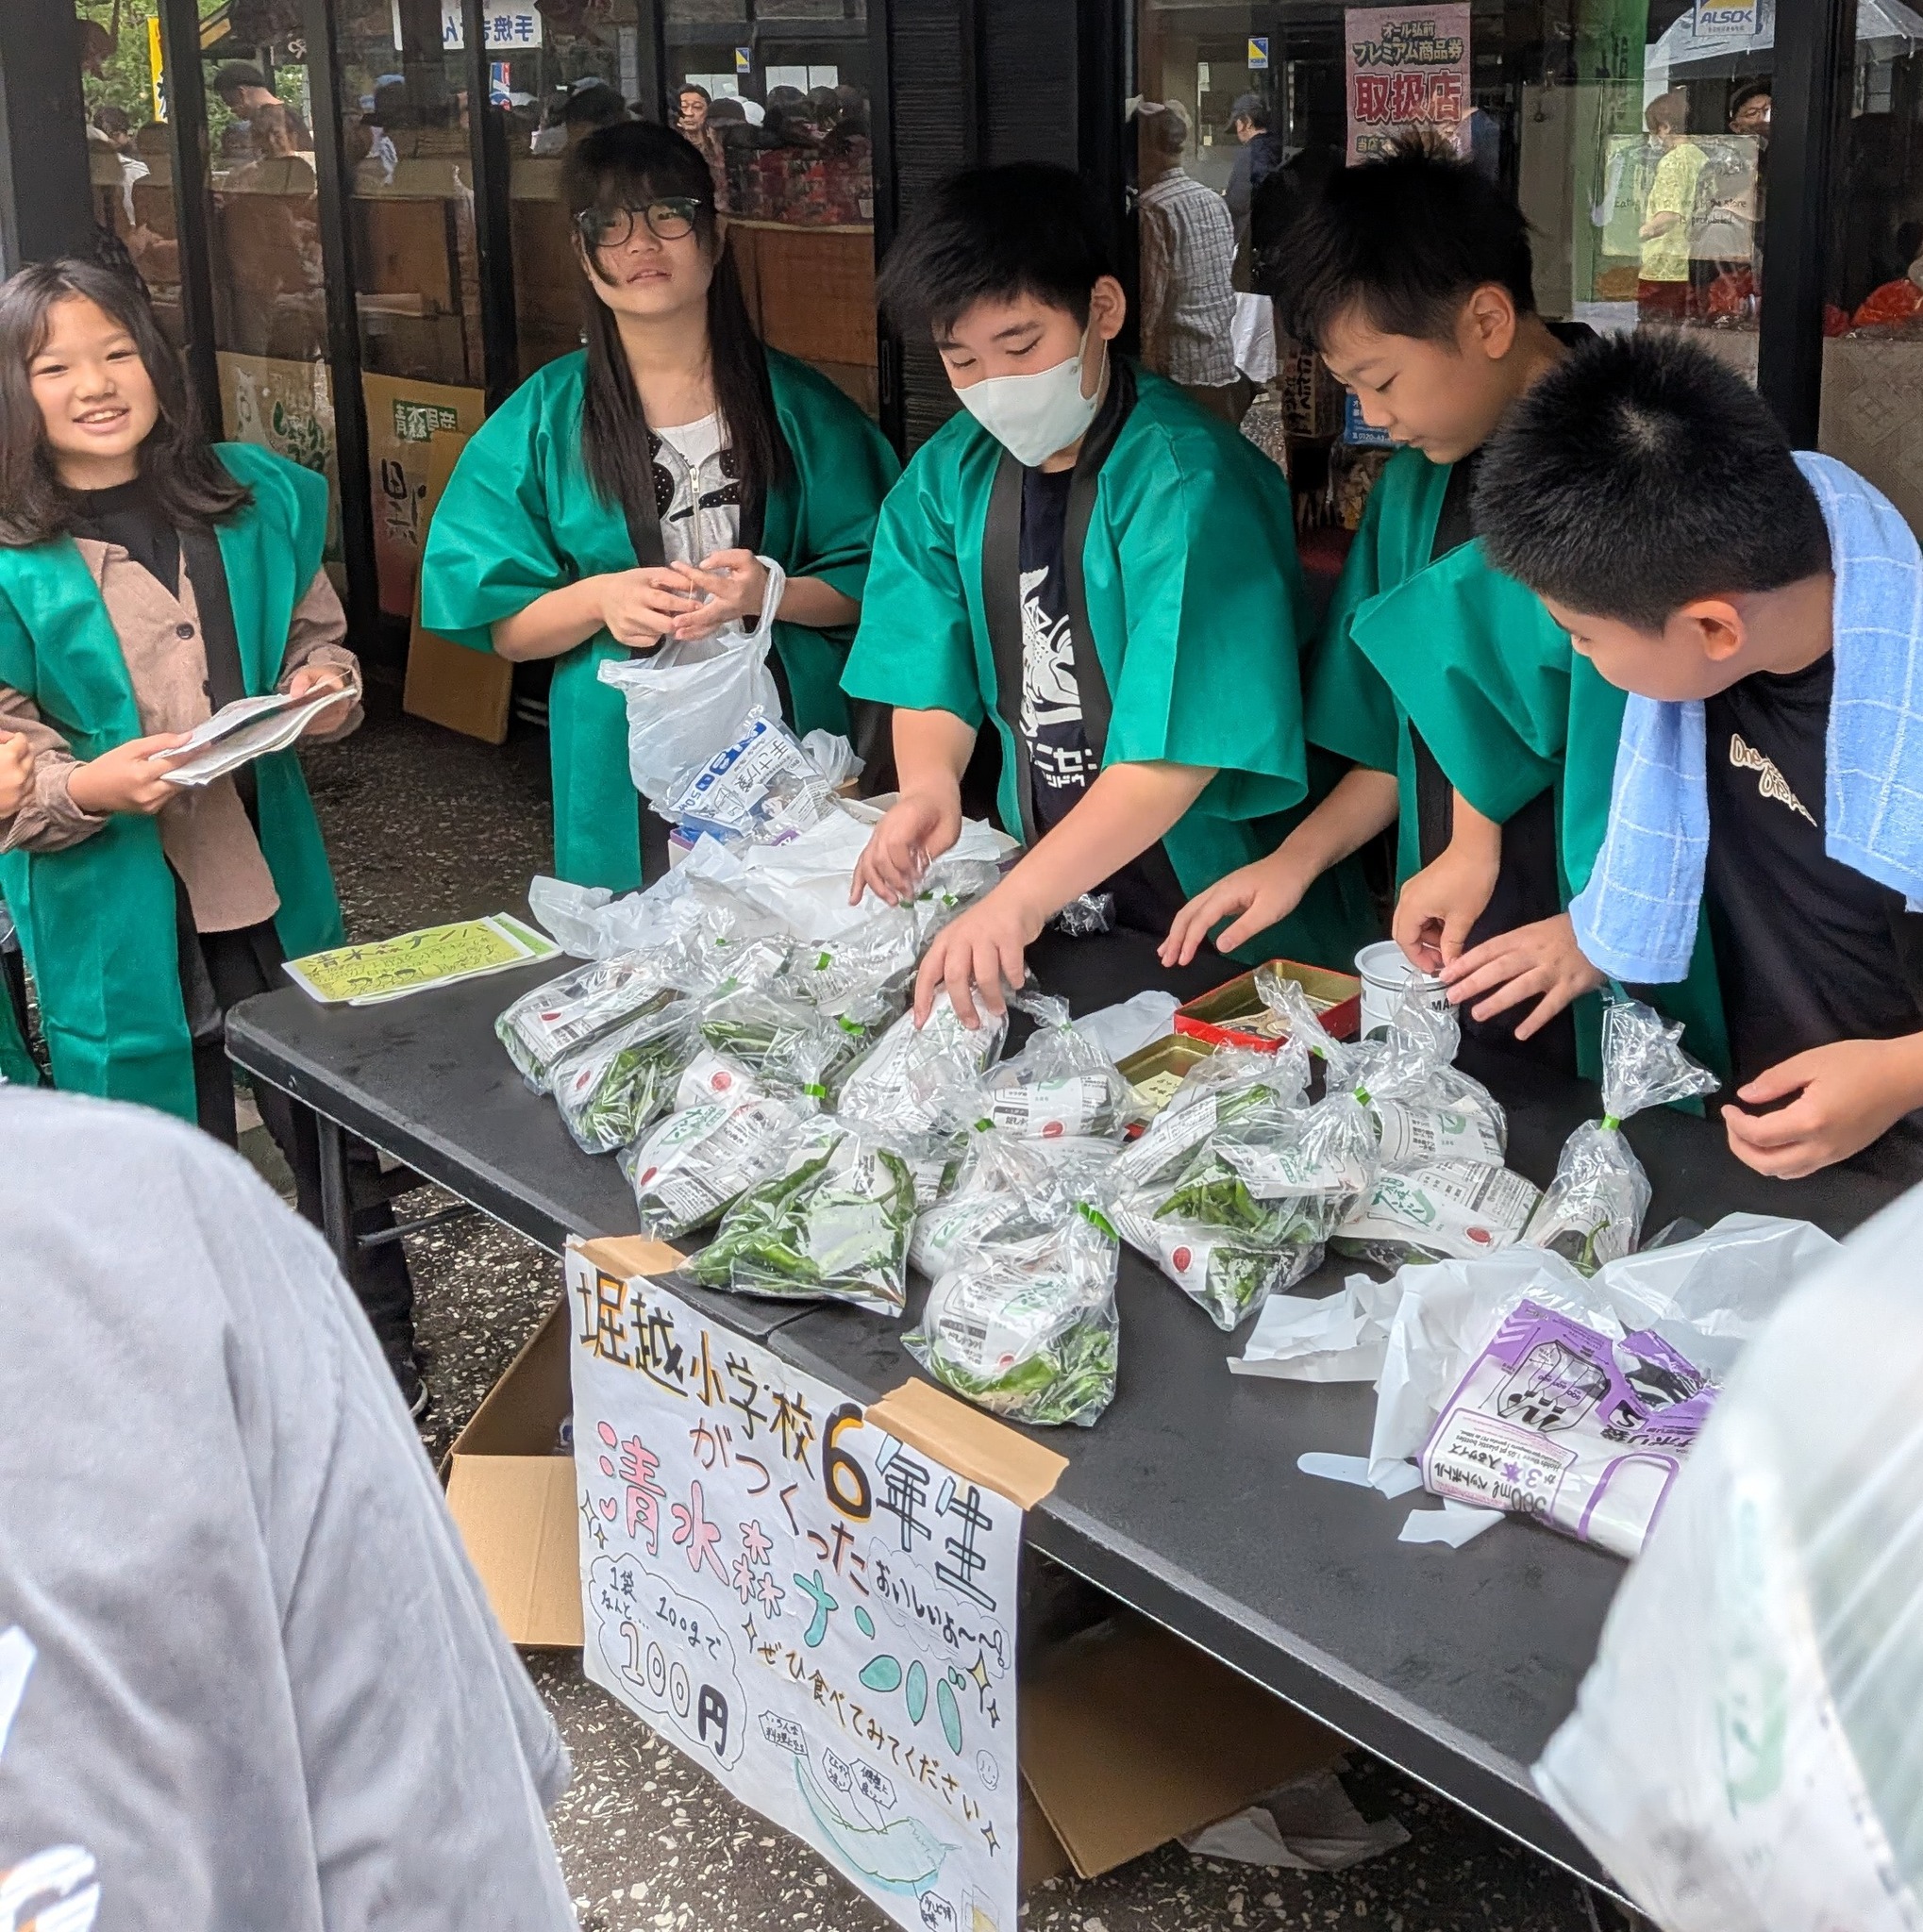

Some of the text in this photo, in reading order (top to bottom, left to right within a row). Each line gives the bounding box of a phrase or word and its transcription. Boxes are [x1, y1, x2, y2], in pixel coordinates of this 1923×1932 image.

[1381, 21, 1436, 39] オール弘前
[1699, 9, 1753, 25] ALSOK
[1352, 37, 1463, 65] プレミアム商品券
[1354, 69, 1463, 124] 取扱店
[1478, 1441, 1499, 1453] plastic
[689, 1418, 870, 1596] がつくった
[619, 1620, 728, 1757] 100円
[758, 1641, 979, 1820] ぜひ食べてみてください
